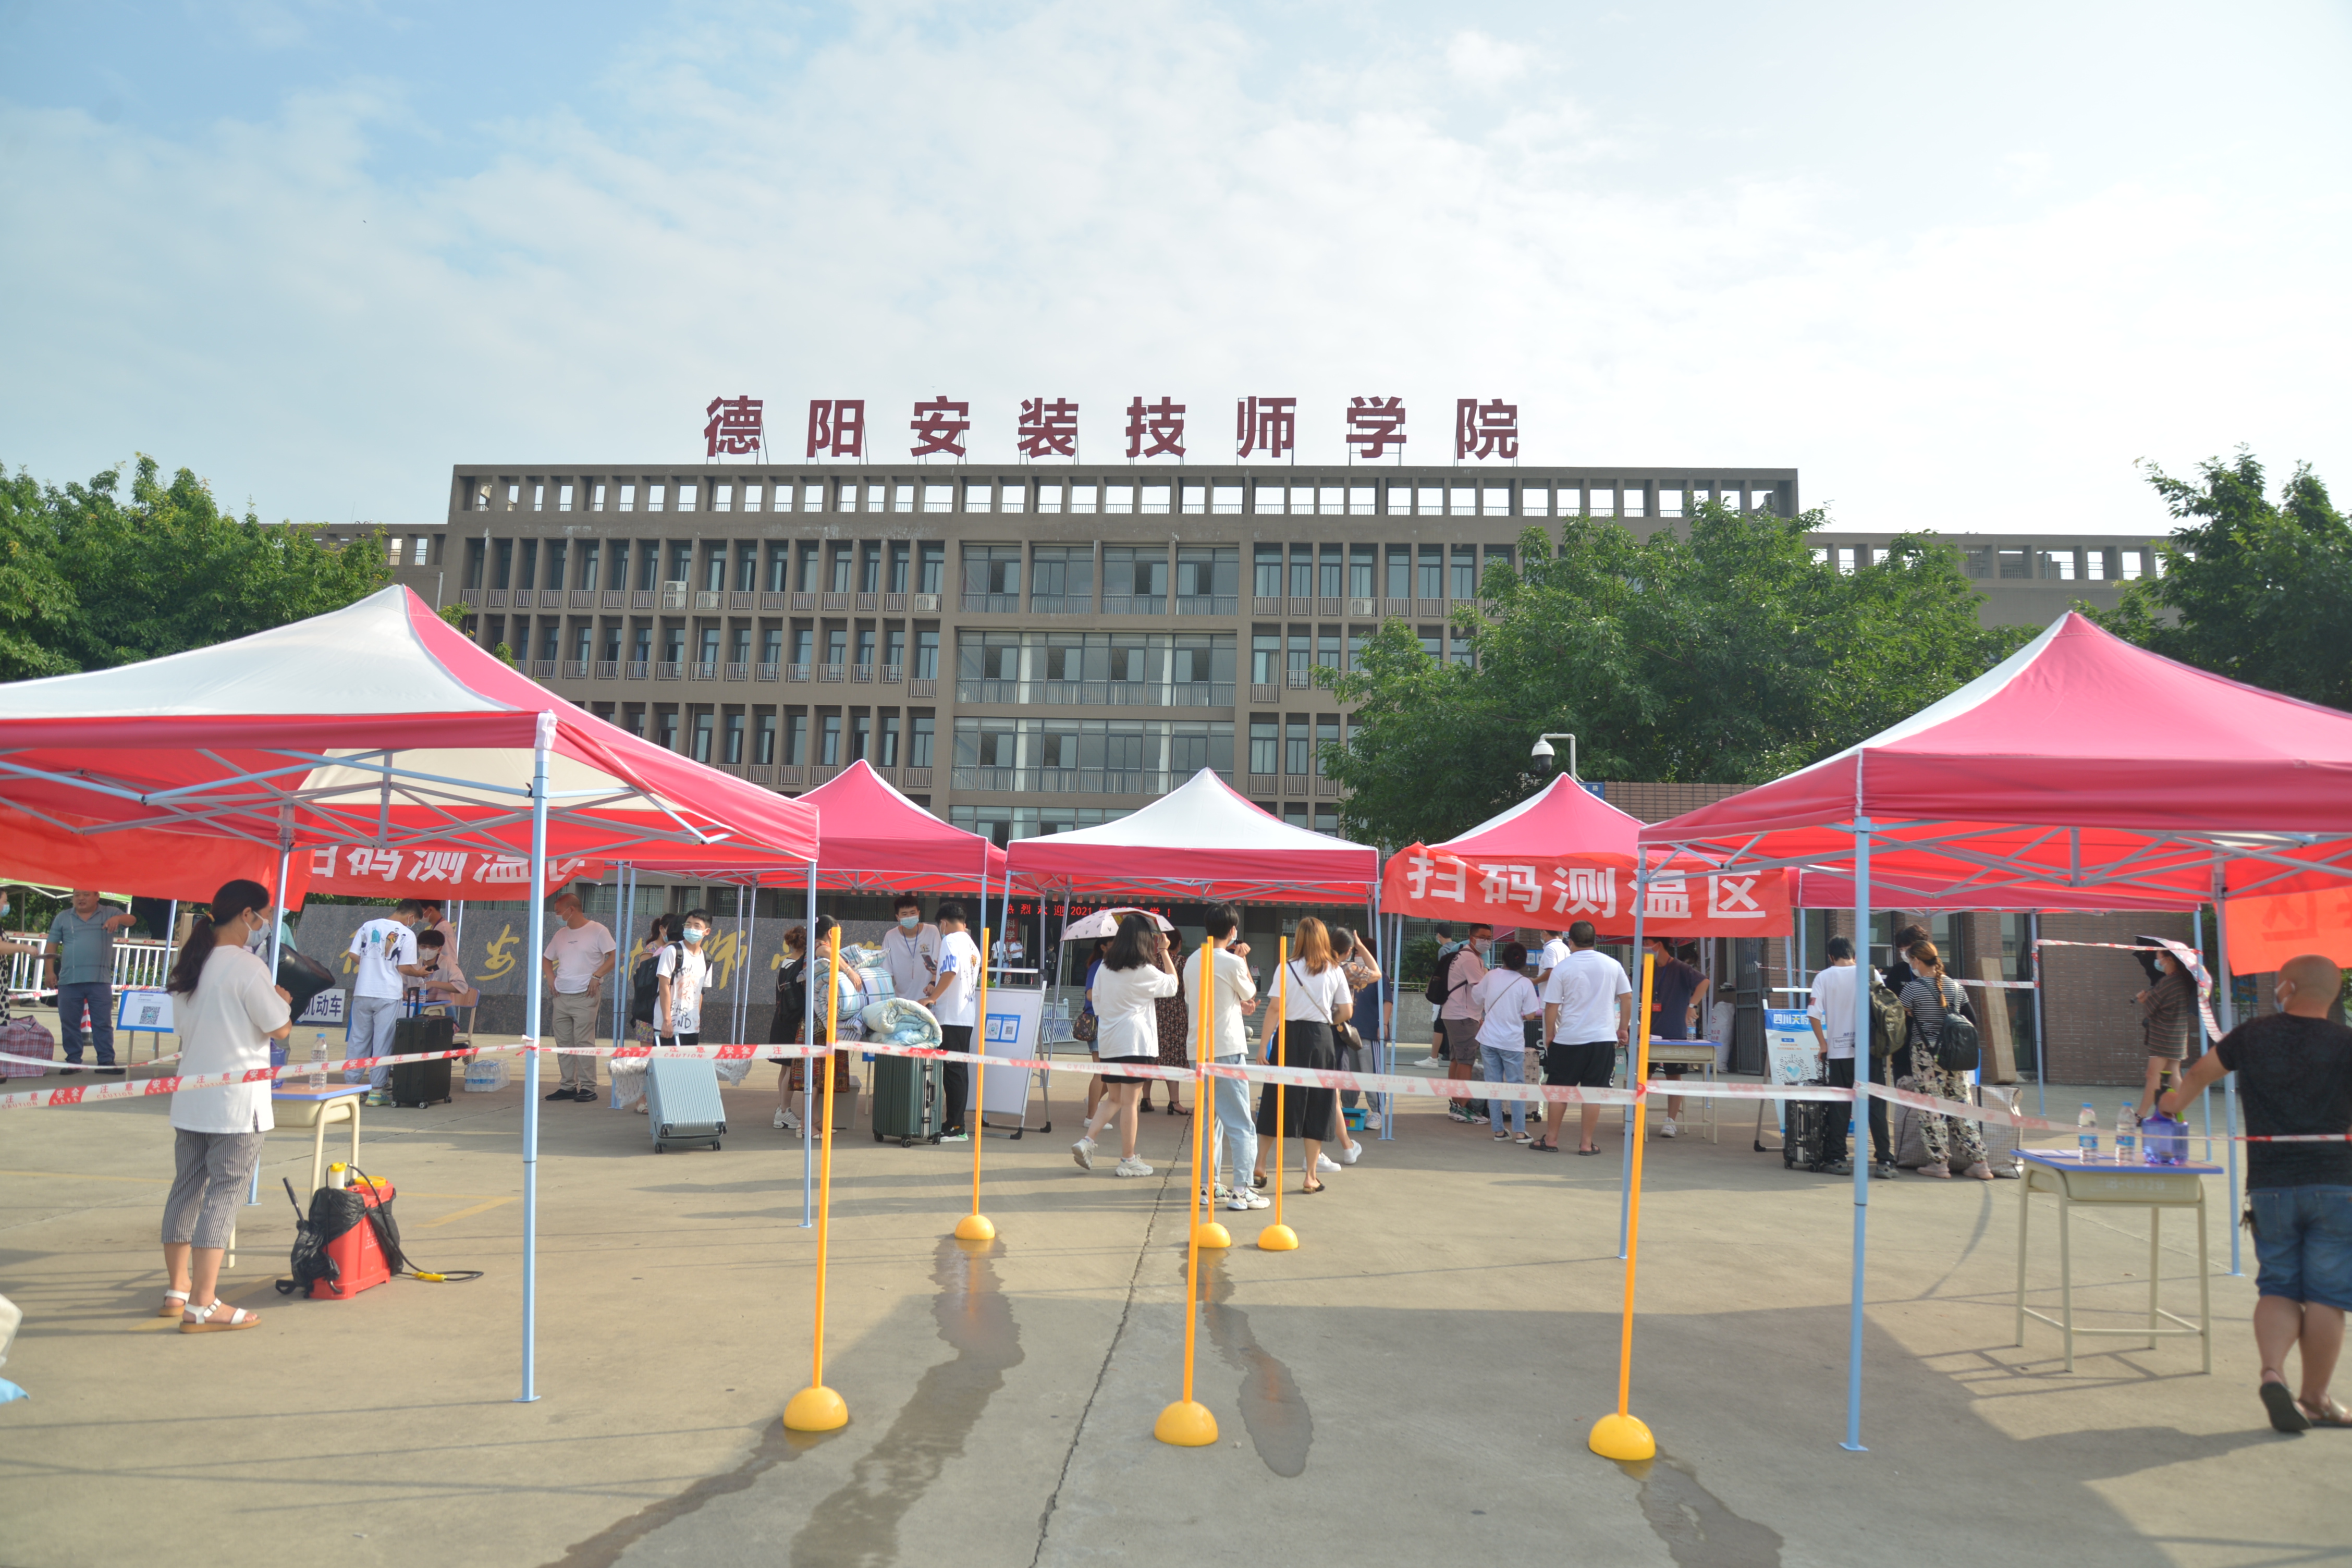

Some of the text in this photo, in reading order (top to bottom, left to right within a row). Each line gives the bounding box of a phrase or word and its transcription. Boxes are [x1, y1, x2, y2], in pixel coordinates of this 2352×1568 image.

[704, 395, 1520, 459] 德阳安装技师学院
[1407, 855, 1766, 919] 扫码测温区
[725, 1046, 751, 1055] 安全
[773, 1046, 809, 1055] 注意
[295, 1062, 329, 1074] 注意
[349, 1058, 373, 1068] 安全
[197, 1072, 230, 1084] 注意
[250, 1068, 273, 1079] 安全
[100, 1082, 133, 1094] 注意
[152, 1077, 176, 1088] 安全
[6, 1092, 38, 1104] 注意
[56, 1087, 80, 1099] 安全
[2, 1101, 38, 1110] CAUTION
[53, 1097, 78, 1105] SAFE
